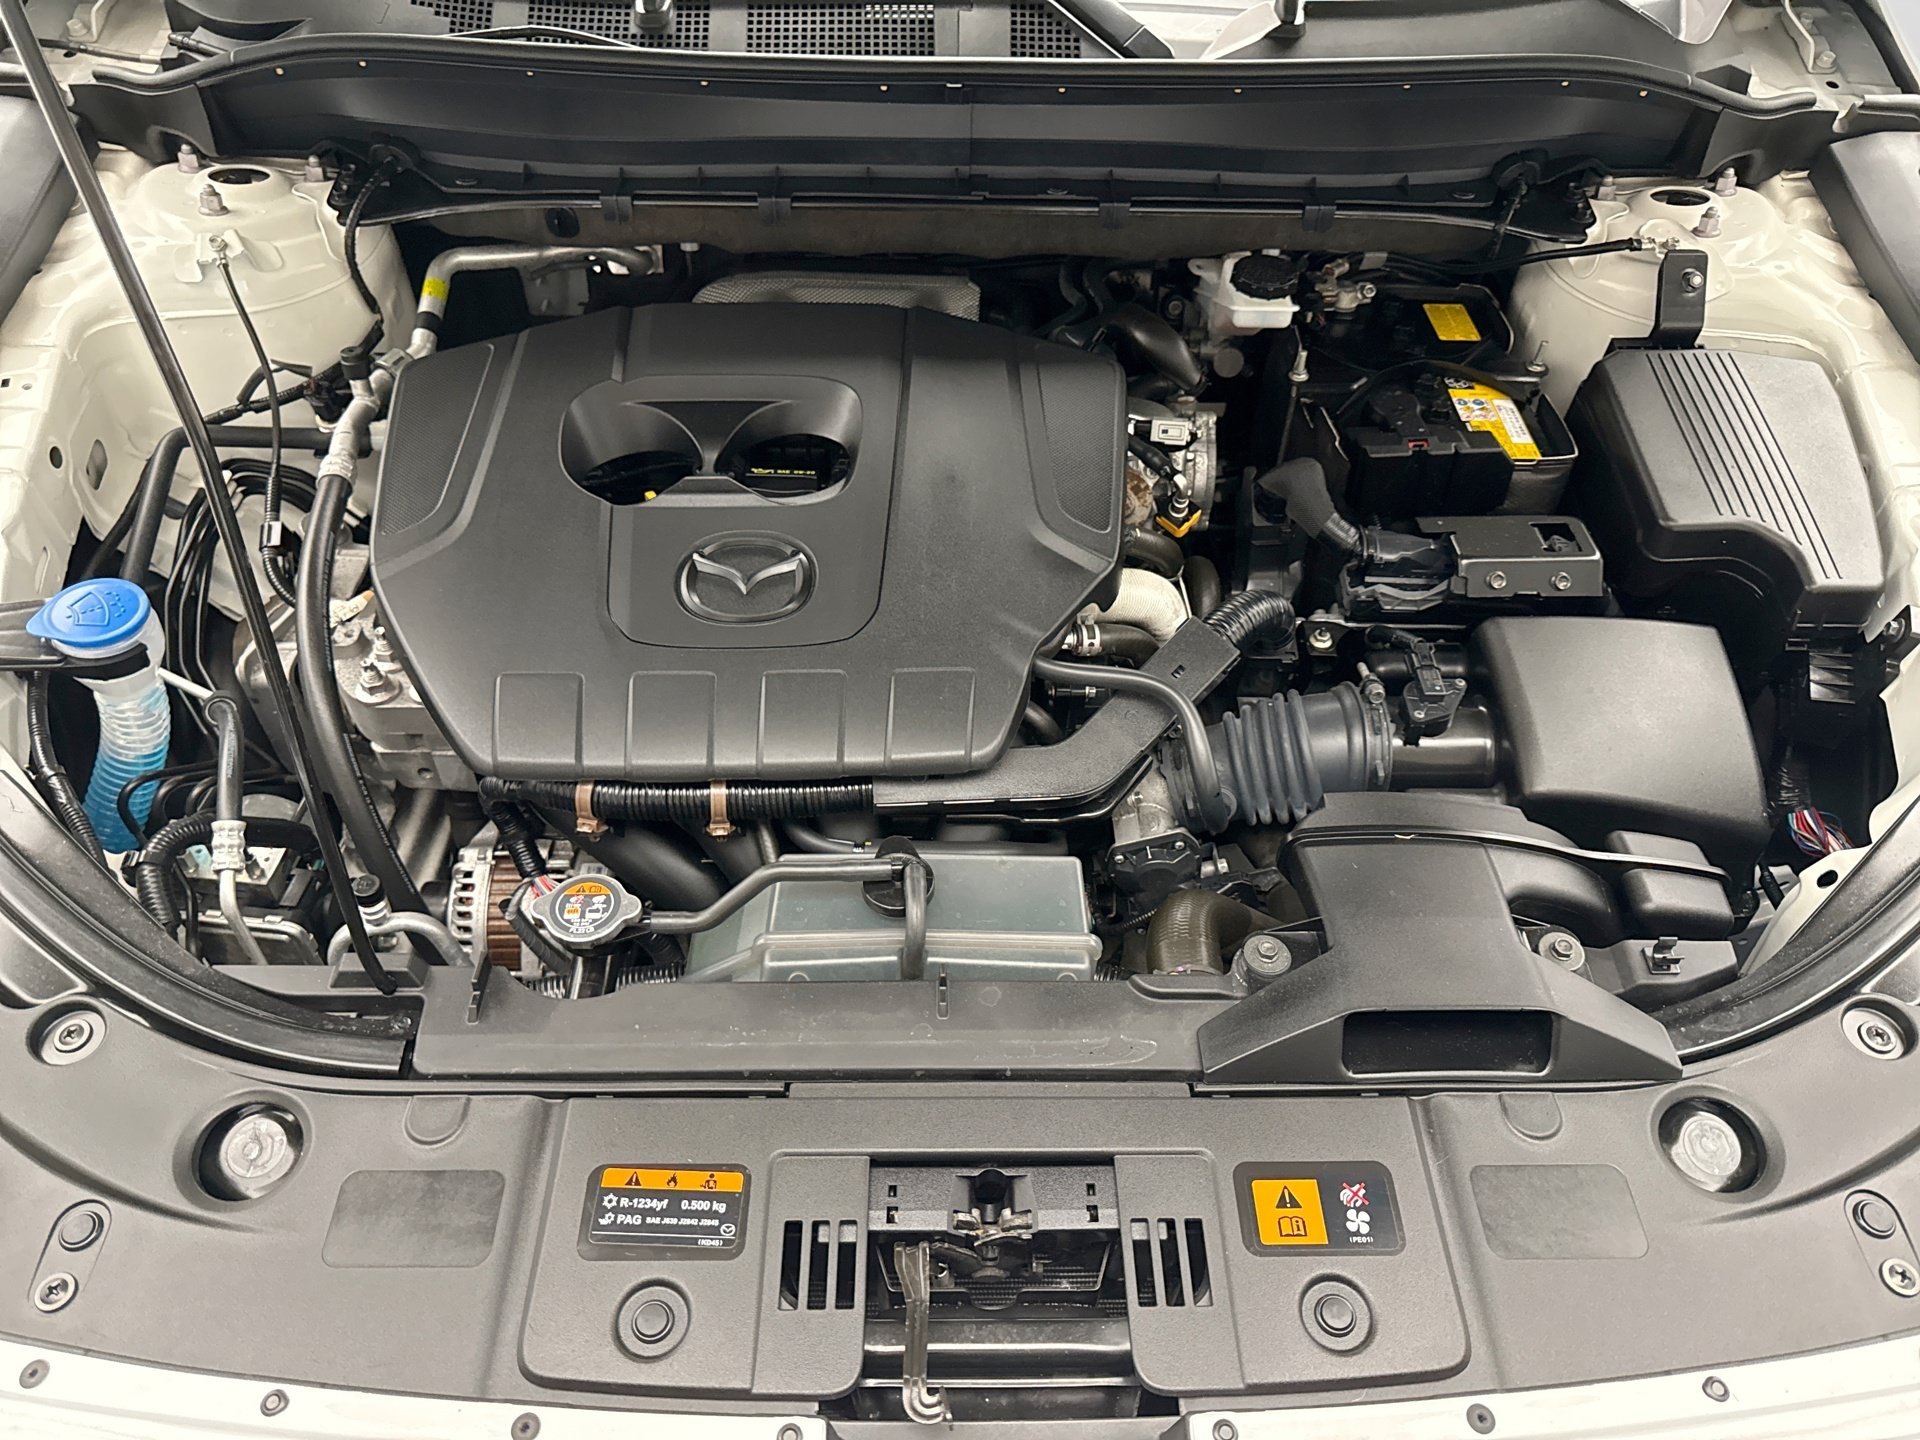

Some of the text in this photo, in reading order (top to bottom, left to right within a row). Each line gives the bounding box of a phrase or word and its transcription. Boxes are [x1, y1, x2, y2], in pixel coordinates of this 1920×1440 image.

[619, 1198, 727, 1213] R-1234yf 0.500 kg
[616, 1215, 642, 1225] PAG
